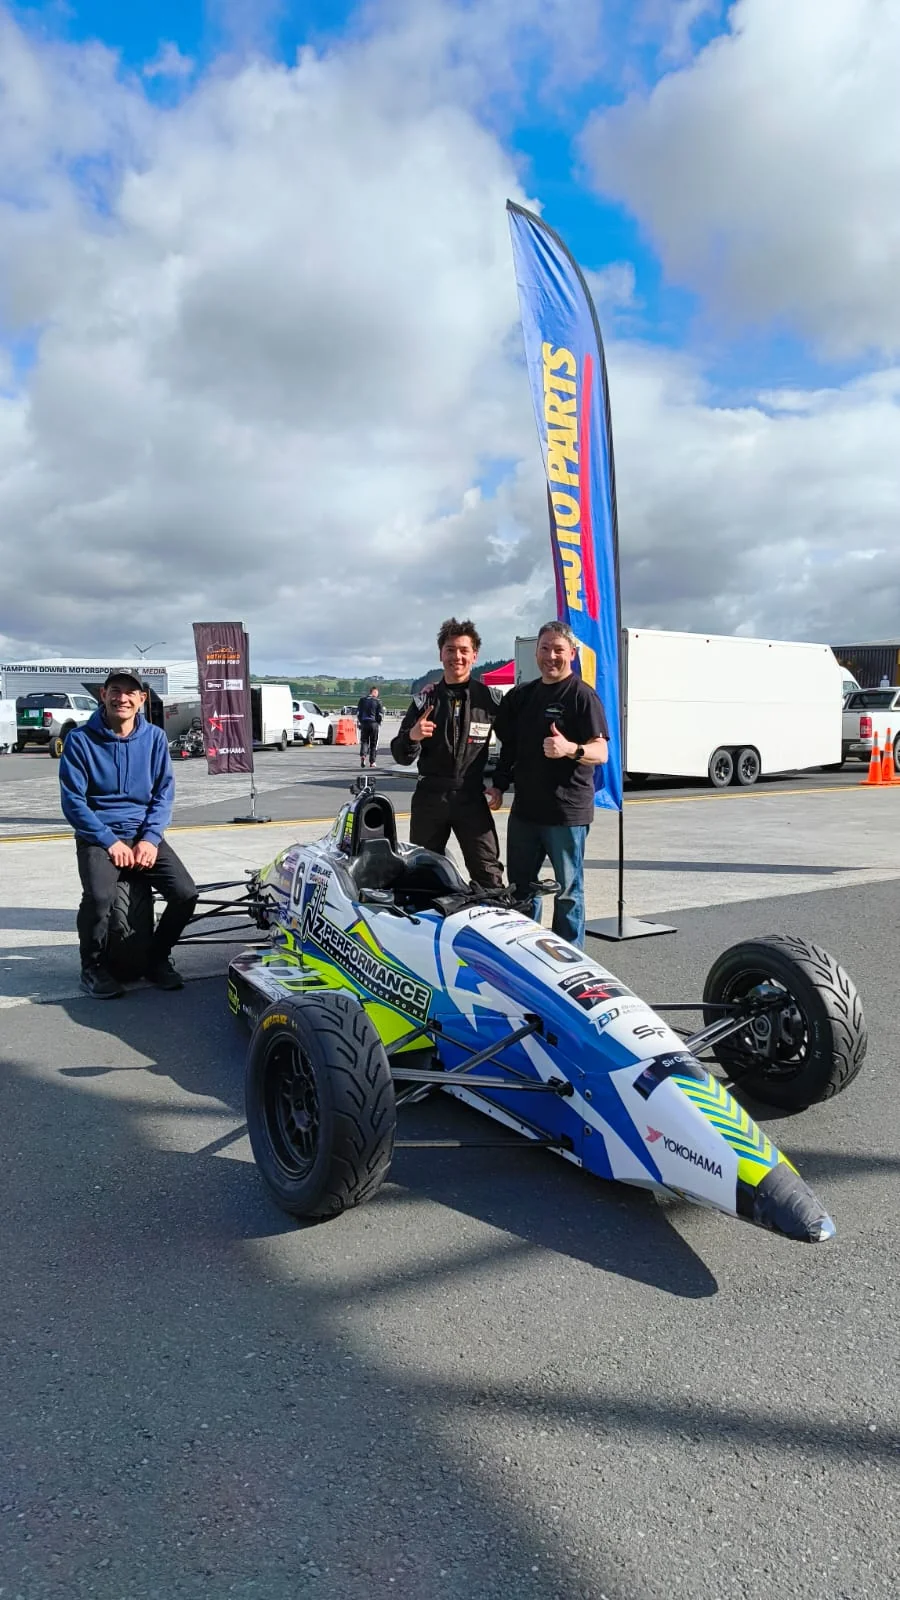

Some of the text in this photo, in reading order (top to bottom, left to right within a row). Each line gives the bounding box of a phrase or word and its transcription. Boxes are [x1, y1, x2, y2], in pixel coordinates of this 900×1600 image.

[542, 342, 580, 487] PARTS
[294, 861, 305, 906] 6
[535, 938, 584, 963] 6
[663, 1136, 723, 1179] YOKOHAMA
